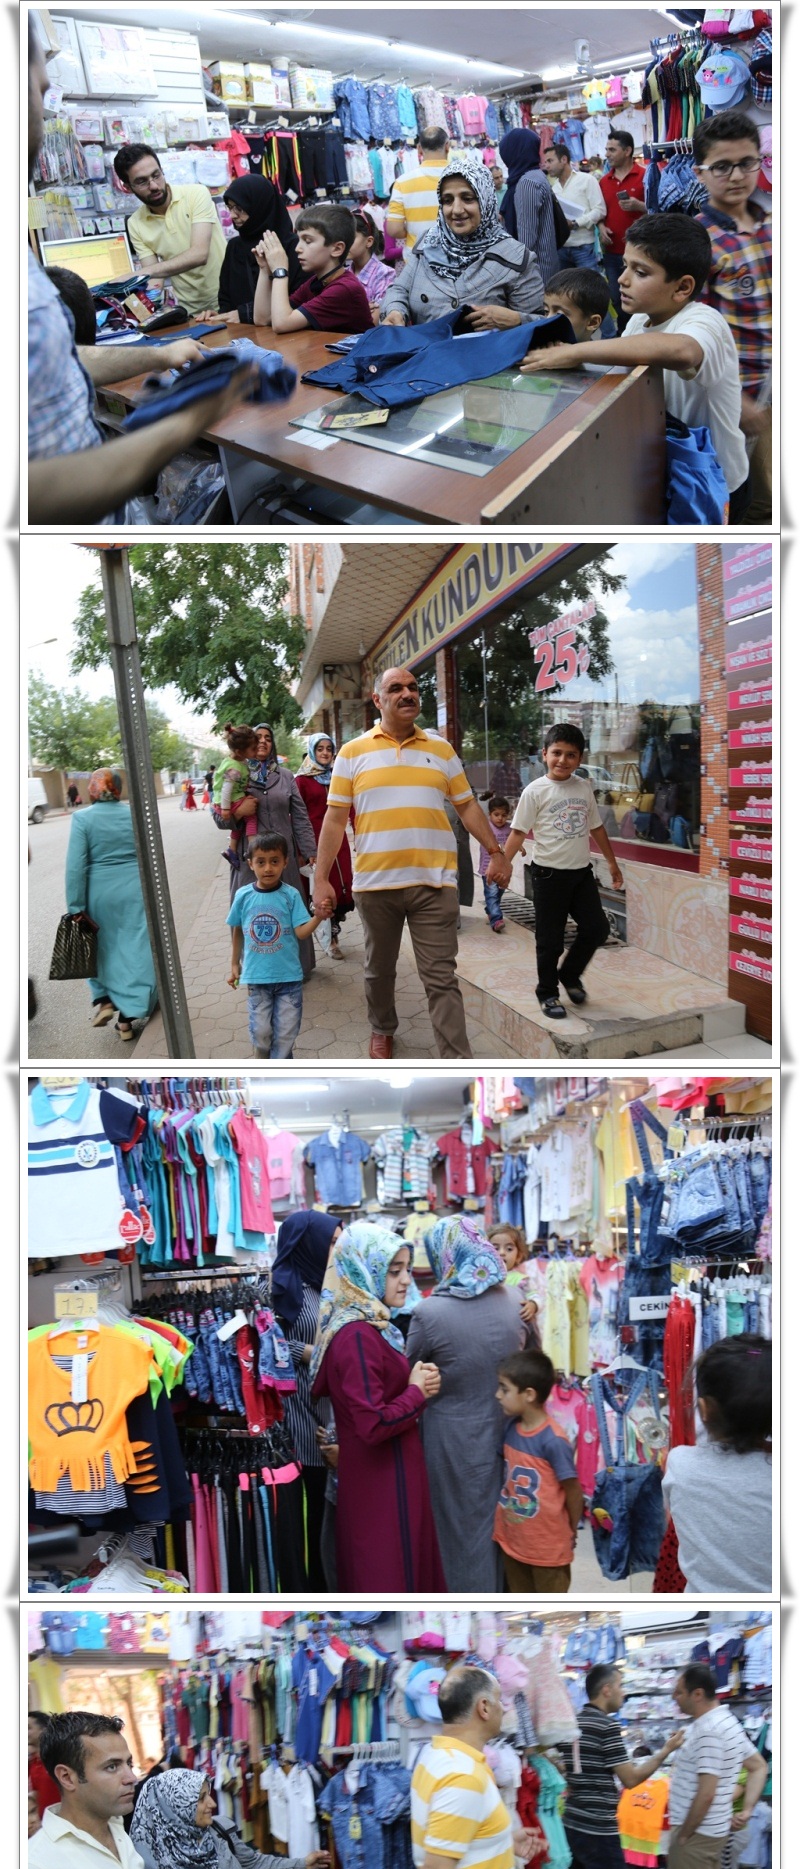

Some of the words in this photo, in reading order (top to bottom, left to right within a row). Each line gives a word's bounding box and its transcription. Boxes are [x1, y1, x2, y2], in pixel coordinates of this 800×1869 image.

[740, 275, 755, 296] 9
[421, 543, 546, 647] KUNDUR
[256, 925, 273, 937] 73
